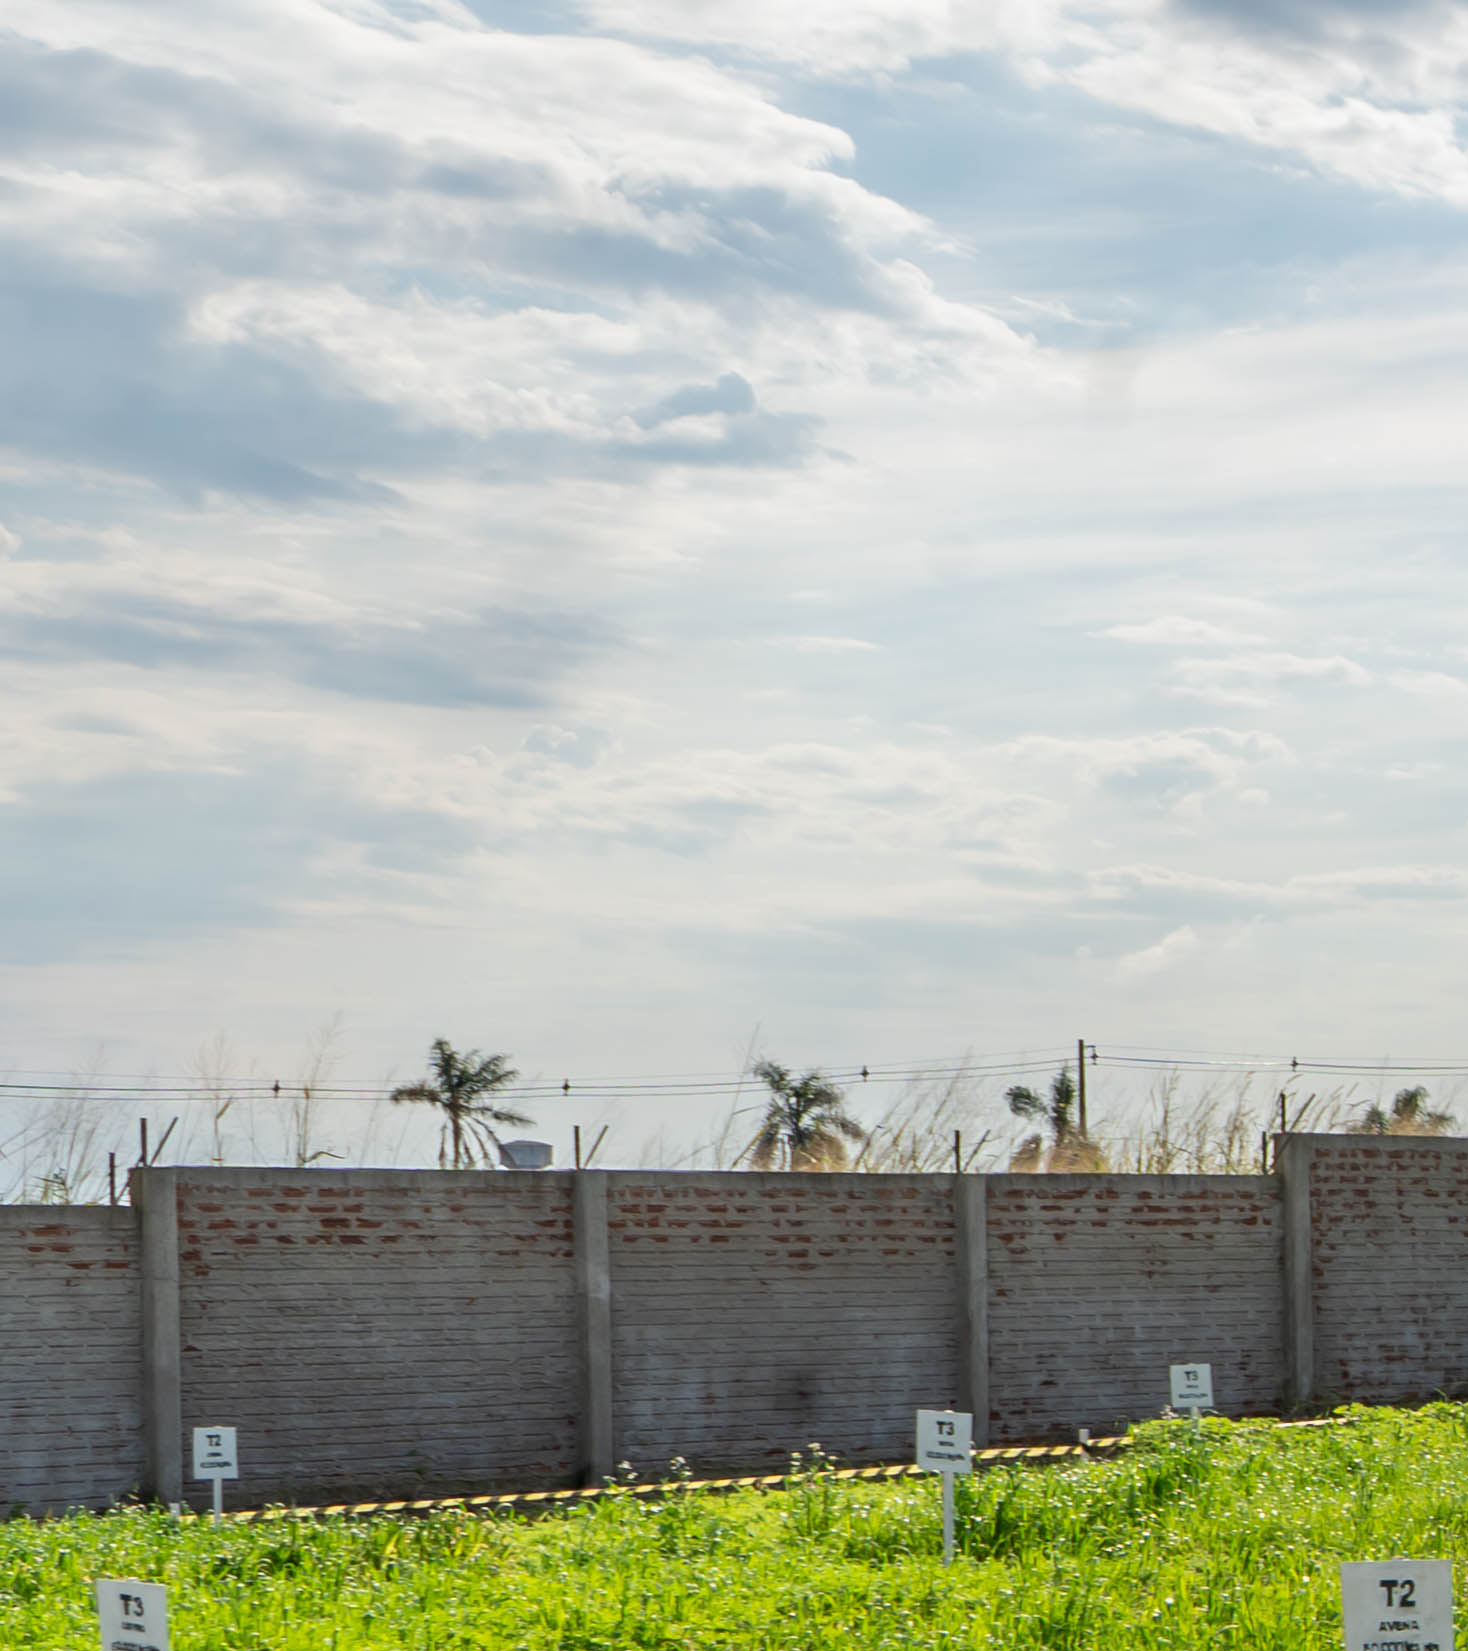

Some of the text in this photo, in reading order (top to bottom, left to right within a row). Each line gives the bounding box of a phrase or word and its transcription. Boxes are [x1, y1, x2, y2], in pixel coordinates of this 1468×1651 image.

[119, 1593, 144, 1617] T3
[1379, 1580, 1415, 1607] T2
[1379, 1621, 1419, 1631] AVENA
